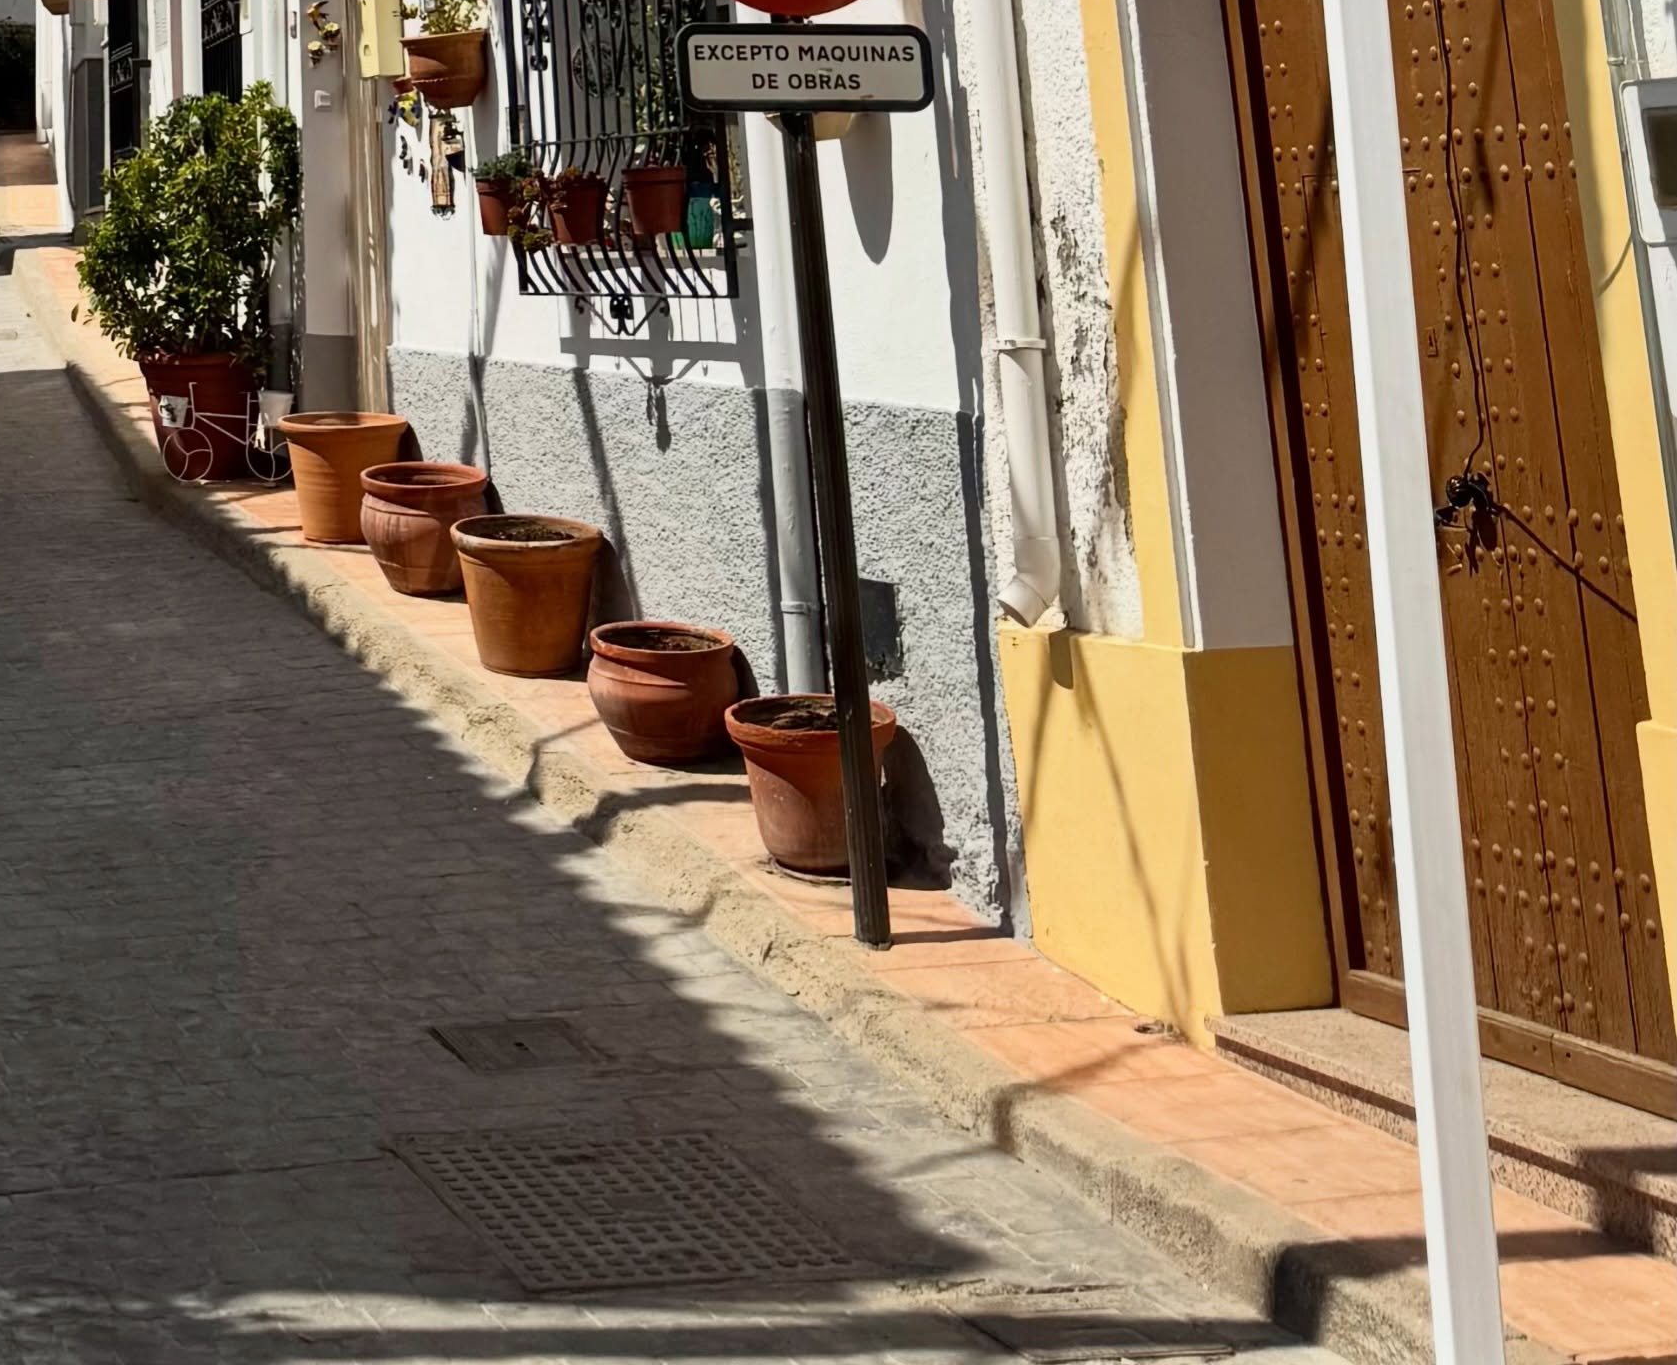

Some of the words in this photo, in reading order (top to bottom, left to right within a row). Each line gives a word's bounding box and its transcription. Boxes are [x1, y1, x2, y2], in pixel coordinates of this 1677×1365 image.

[693, 44, 790, 62] EXCEPTO
[798, 44, 915, 63] MAQUINAS
[752, 73, 779, 90] DE
[788, 73, 861, 91] OBRAS
